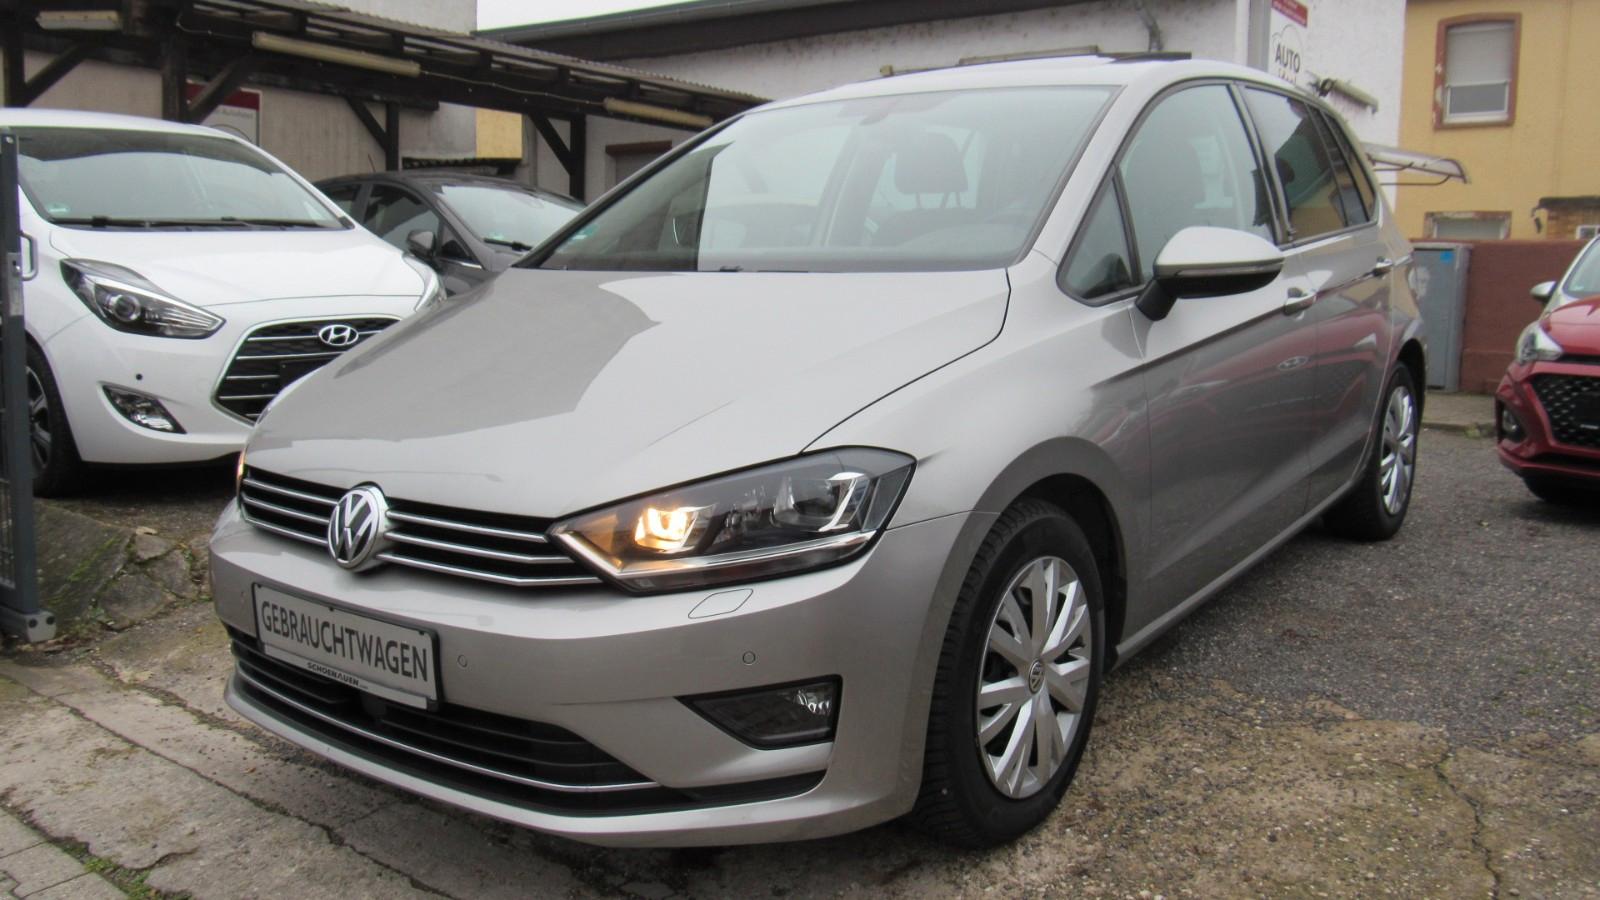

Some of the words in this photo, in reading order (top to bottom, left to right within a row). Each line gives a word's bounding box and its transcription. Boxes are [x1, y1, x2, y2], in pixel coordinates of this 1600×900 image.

[1275, 43, 1301, 73] AUTO
[329, 488, 379, 564] VW
[261, 601, 428, 682] GEBRAUCHTWAGEN
